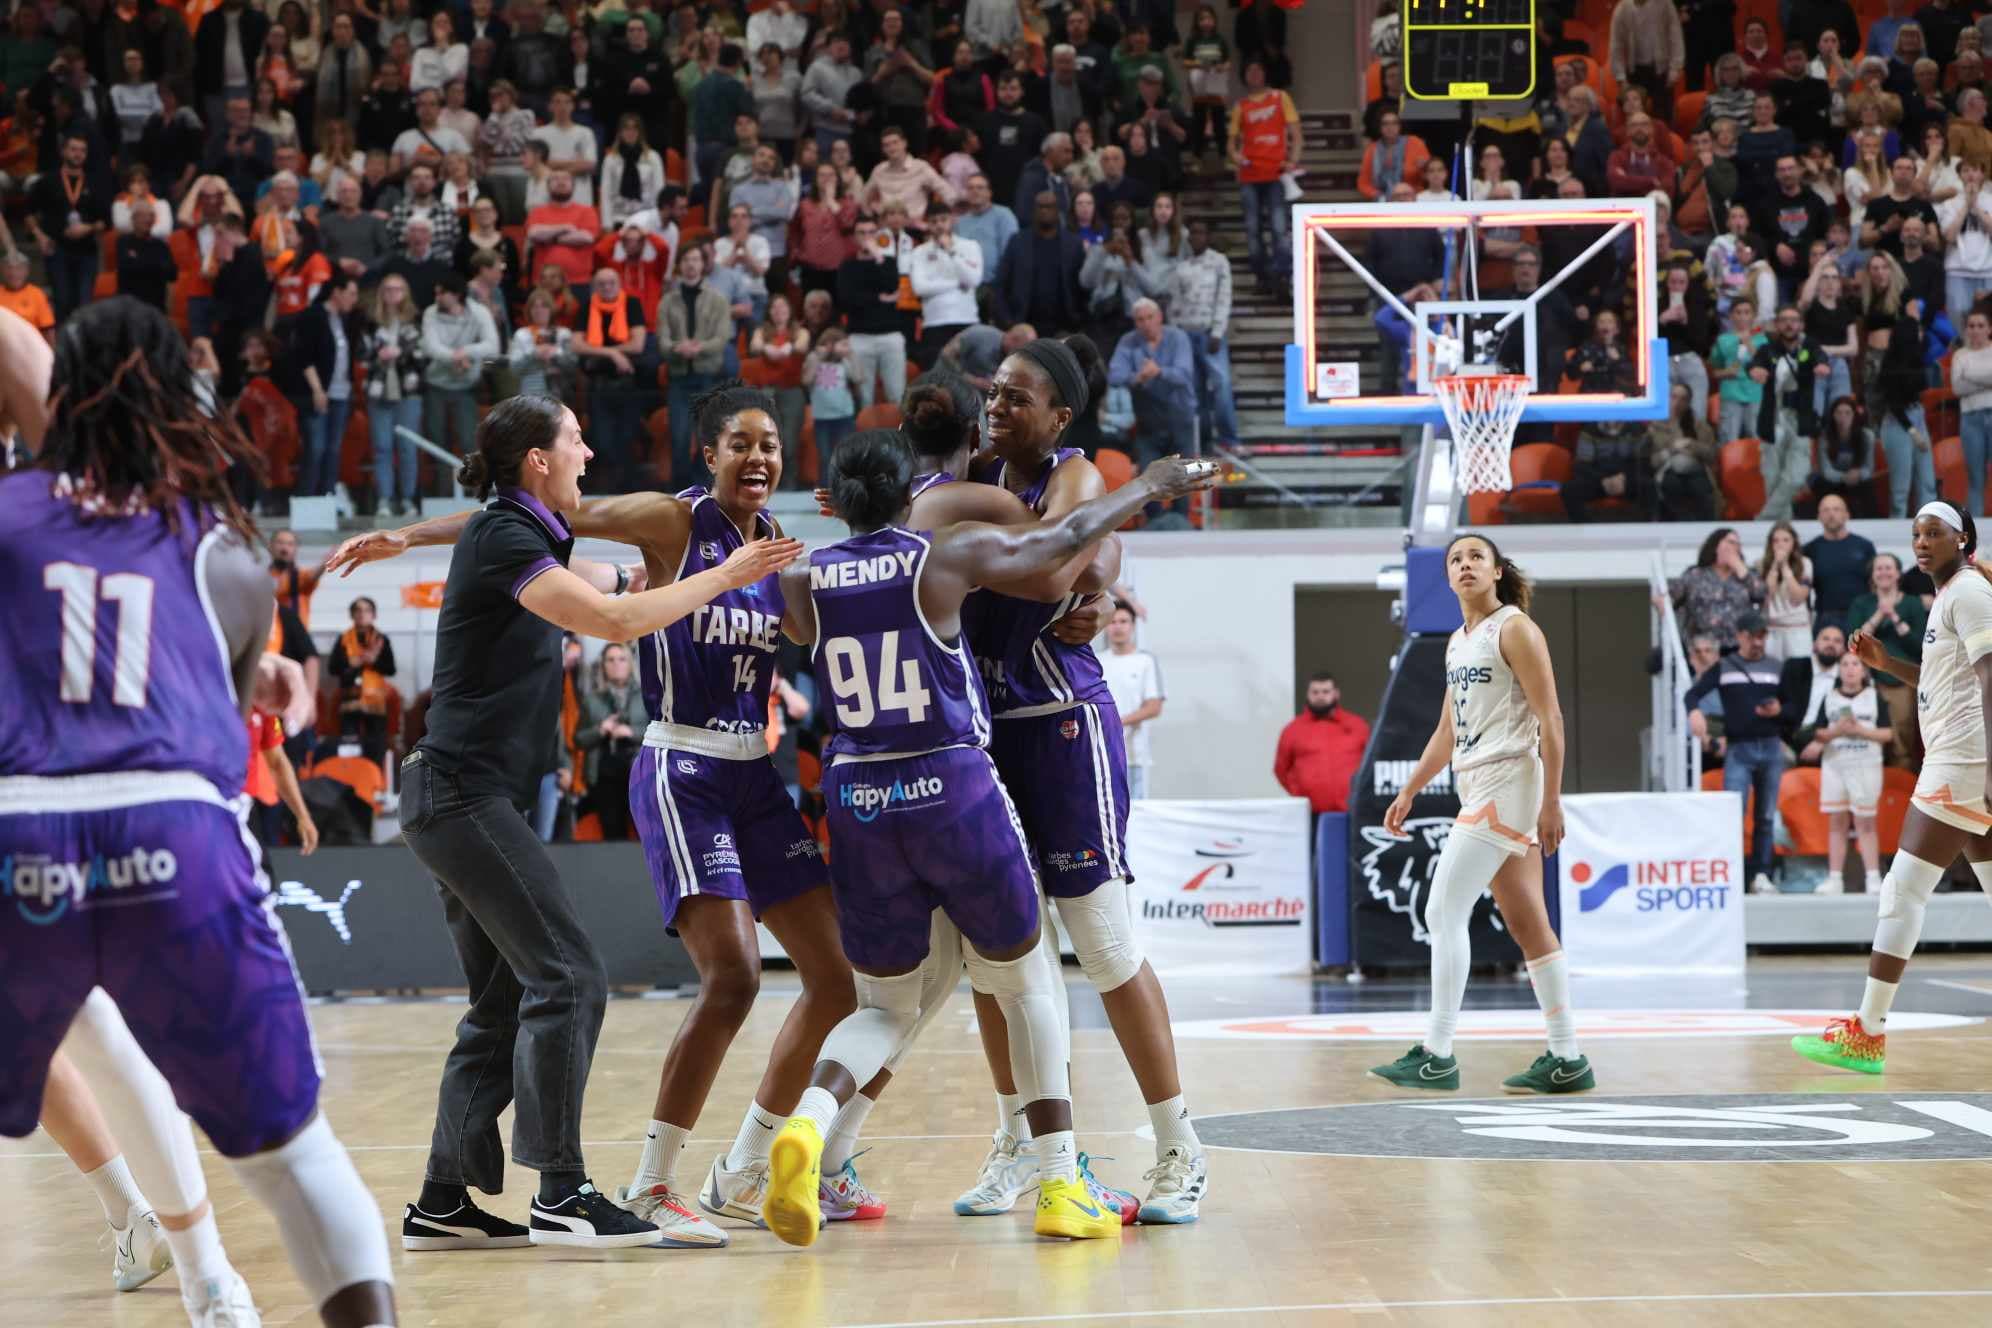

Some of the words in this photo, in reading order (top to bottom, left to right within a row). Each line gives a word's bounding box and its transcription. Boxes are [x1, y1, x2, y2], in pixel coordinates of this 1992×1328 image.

[810, 551, 918, 591] MENDY
[43, 561, 155, 710] 11
[732, 654, 757, 693] 14
[825, 630, 931, 728] 94
[840, 776, 944, 811] HapyAuto
[1637, 859, 1729, 885] INTER
[1142, 898, 1305, 922] Intermarché
[1637, 885, 1730, 911] SPORT
